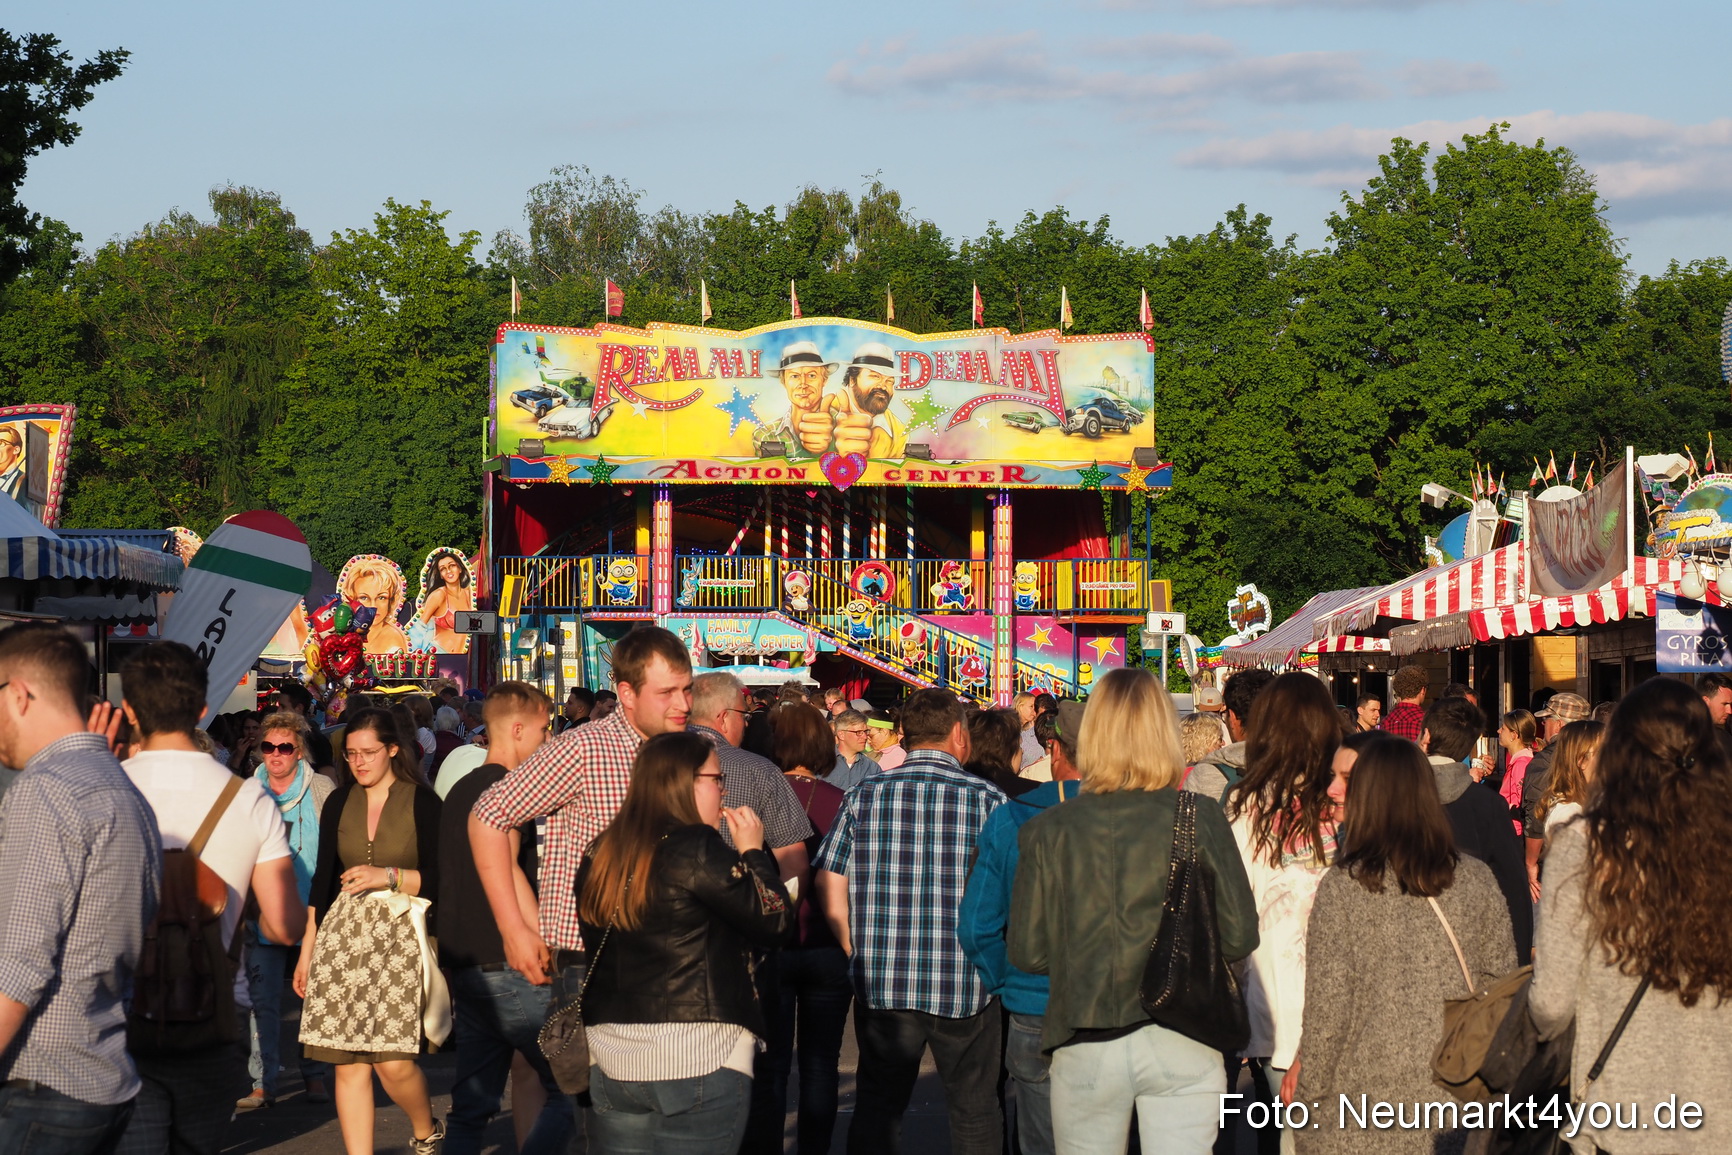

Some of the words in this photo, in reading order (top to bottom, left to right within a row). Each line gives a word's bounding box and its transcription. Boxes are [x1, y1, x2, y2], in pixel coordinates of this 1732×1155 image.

[589, 342, 764, 421] REMMI
[894, 348, 1067, 431] DEMMI
[648, 460, 807, 480] ACTION
[884, 465, 1041, 483] CENTER
[707, 619, 751, 633] FAMILY
[706, 634, 752, 649] ACTION
[759, 634, 804, 649] CENTER
[1667, 634, 1728, 650] GYROS
[1681, 652, 1723, 667] PITA
